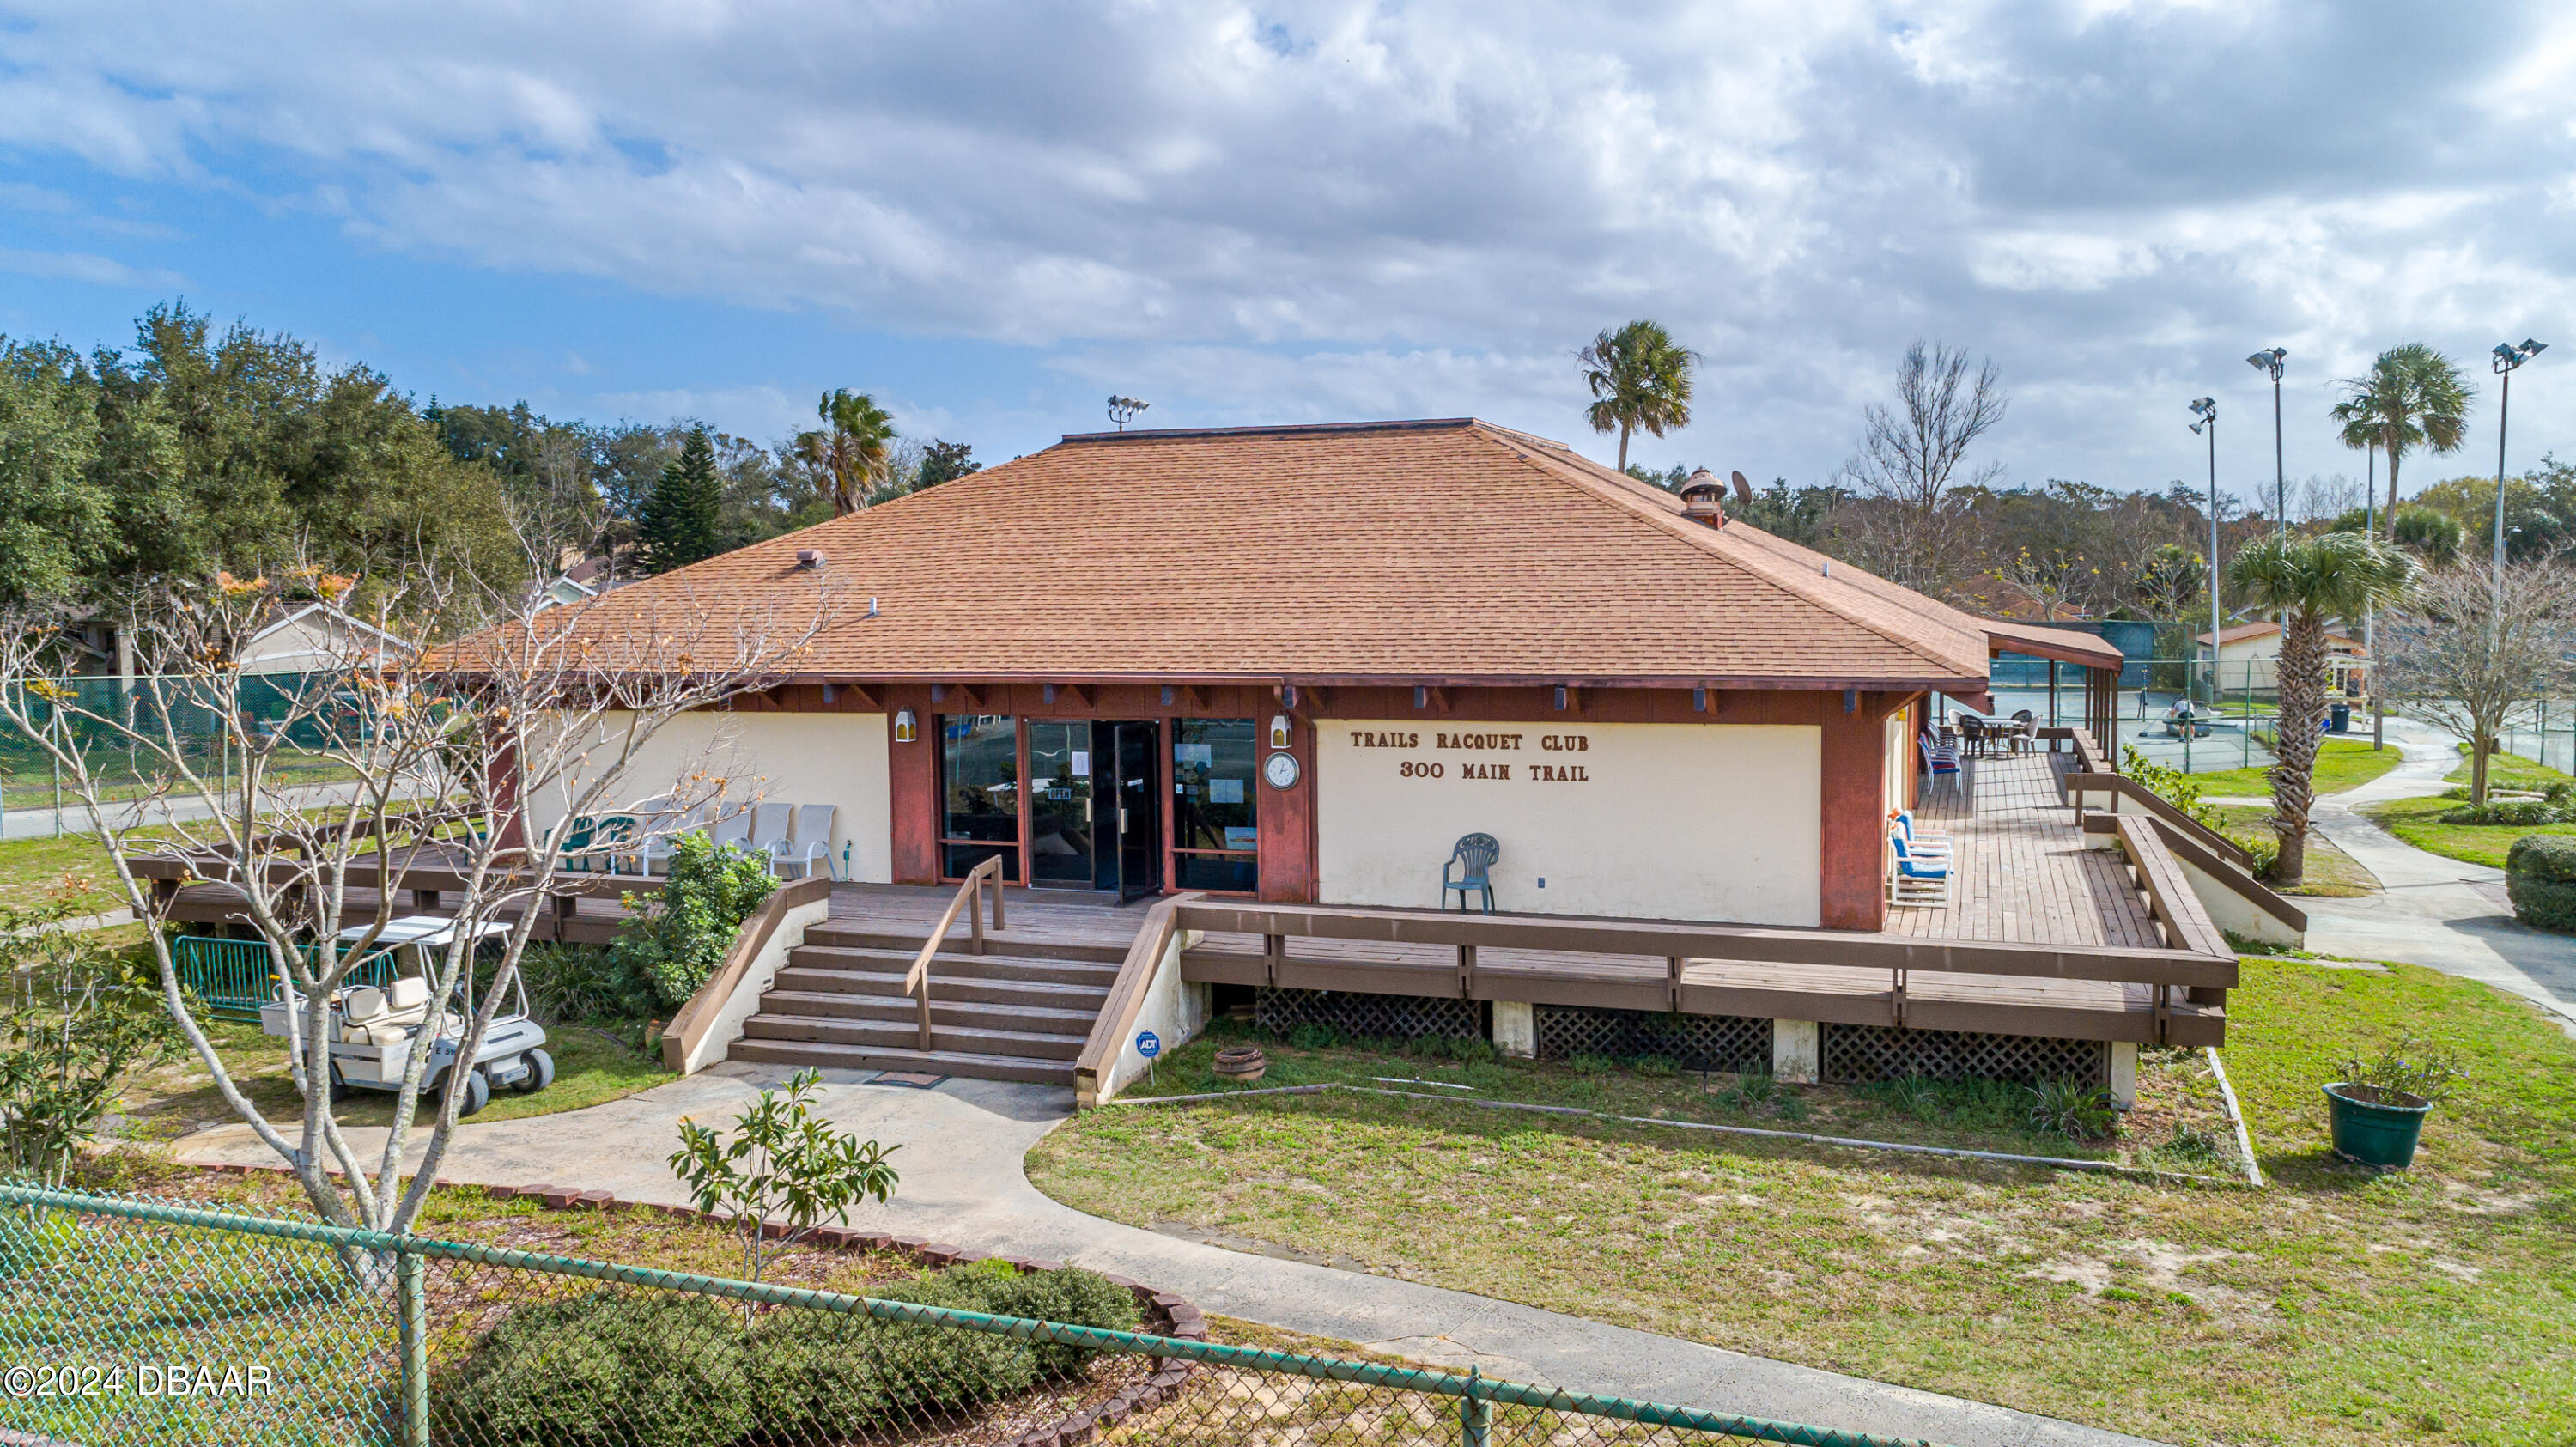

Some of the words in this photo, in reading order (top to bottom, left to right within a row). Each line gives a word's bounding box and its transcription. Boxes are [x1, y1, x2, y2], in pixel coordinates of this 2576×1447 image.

[1351, 732, 1419, 748] TRAILS
[1437, 733, 1523, 750] RACQUET
[1542, 735, 1589, 751] CLUB
[1400, 762, 1444, 778] 300
[1462, 763, 1510, 780] MAIN
[1529, 765, 1589, 781] TRAIL
[1050, 789, 1070, 799] OPEN
[1140, 1039, 1157, 1049] ADT
